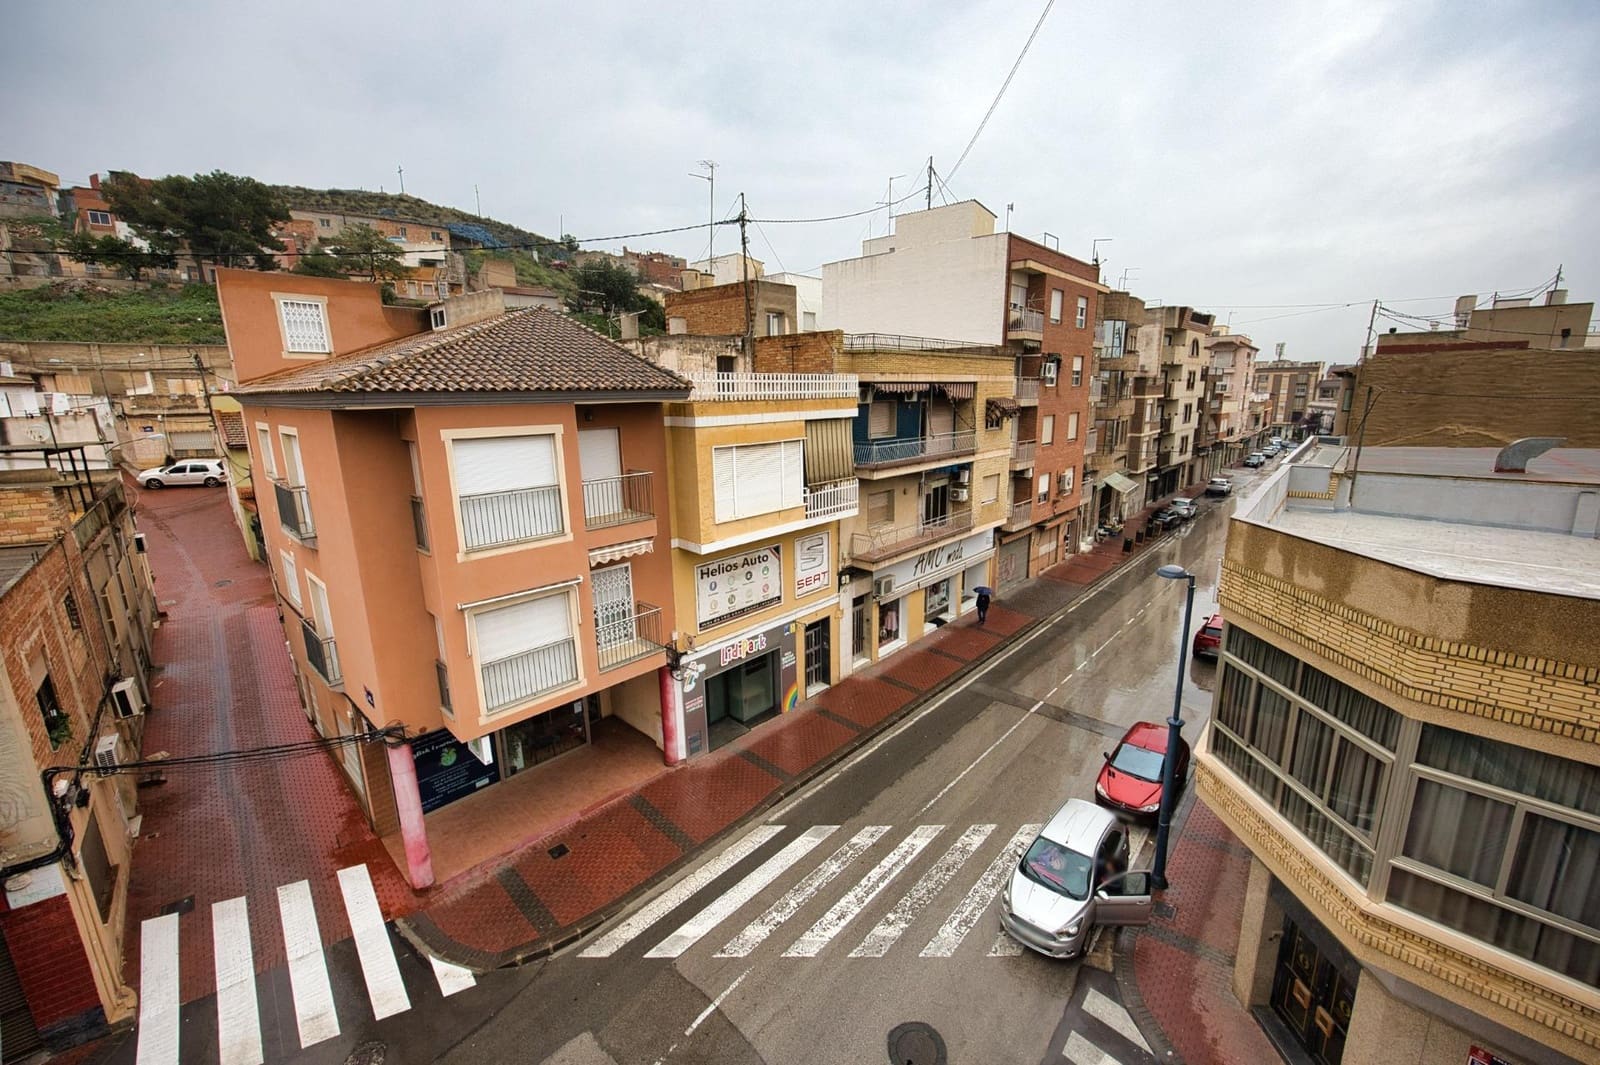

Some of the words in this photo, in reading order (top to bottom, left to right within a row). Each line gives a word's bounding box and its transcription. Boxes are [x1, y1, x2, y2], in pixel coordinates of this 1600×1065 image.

[700, 562, 738, 580] Helios
[741, 554, 769, 569] Auto
[913, 545, 945, 577] AMC
[796, 571, 828, 590] SEAT
